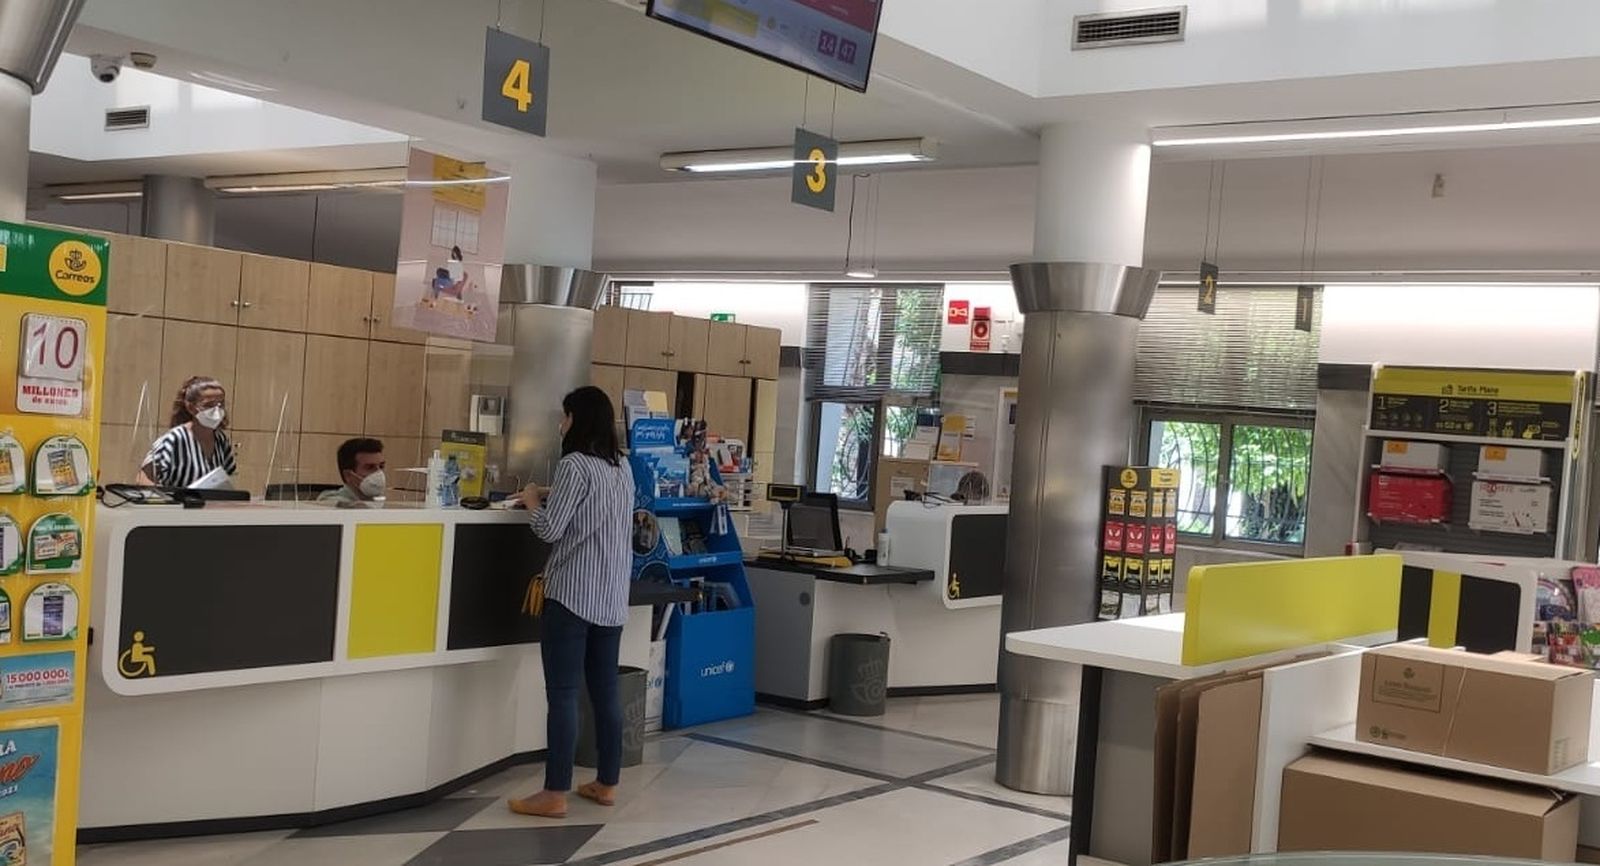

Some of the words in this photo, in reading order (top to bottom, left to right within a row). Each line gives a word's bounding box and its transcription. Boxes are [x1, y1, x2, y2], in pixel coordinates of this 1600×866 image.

[502, 59, 532, 112] 4
[806, 148, 826, 193] 3
[55, 269, 95, 284] Correos
[1204, 274, 1213, 305] 2
[33, 322, 79, 369] 10
[22, 385, 79, 398] MILLONES
[1438, 398, 1449, 413] 2
[1487, 401, 1498, 416] 3
